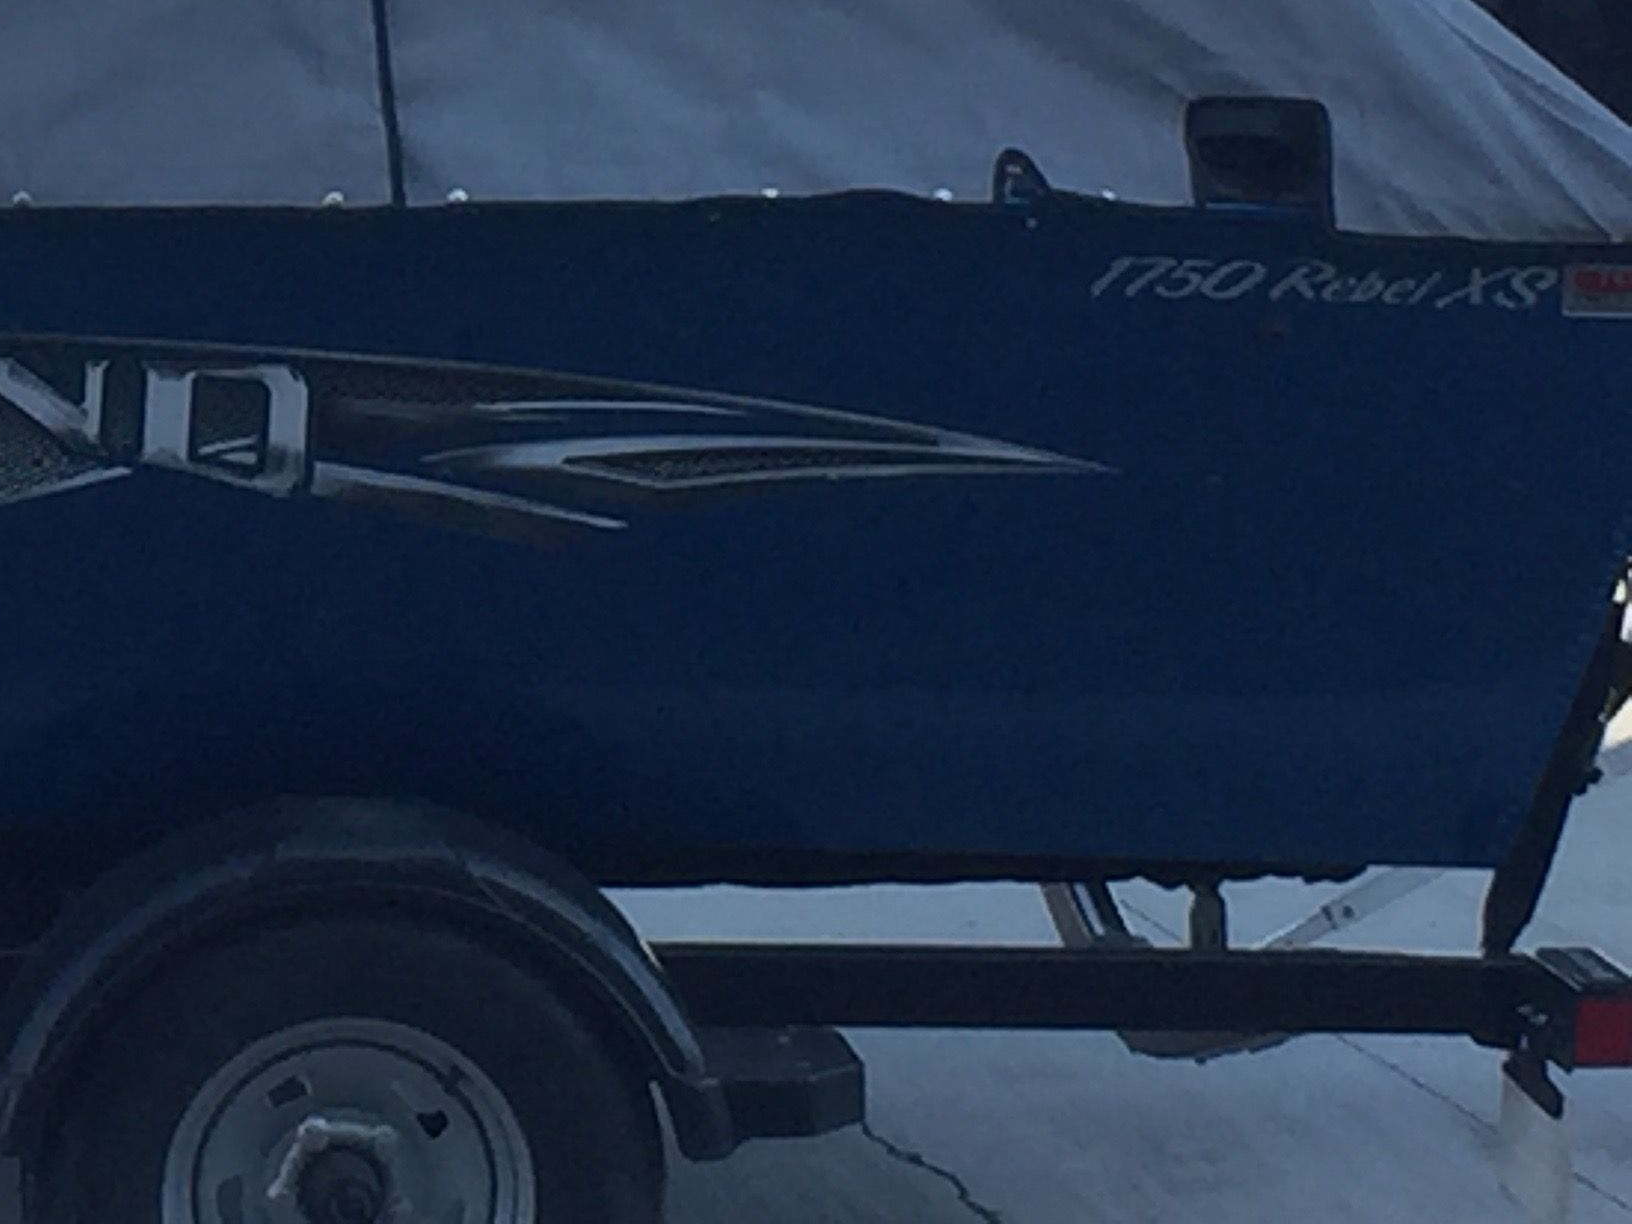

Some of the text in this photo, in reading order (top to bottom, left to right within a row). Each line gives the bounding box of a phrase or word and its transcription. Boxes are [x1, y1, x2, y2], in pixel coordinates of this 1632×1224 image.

[1090, 256, 1267, 301] 1750
[1268, 260, 1443, 307] Rebel
[1434, 265, 1559, 310] XS
